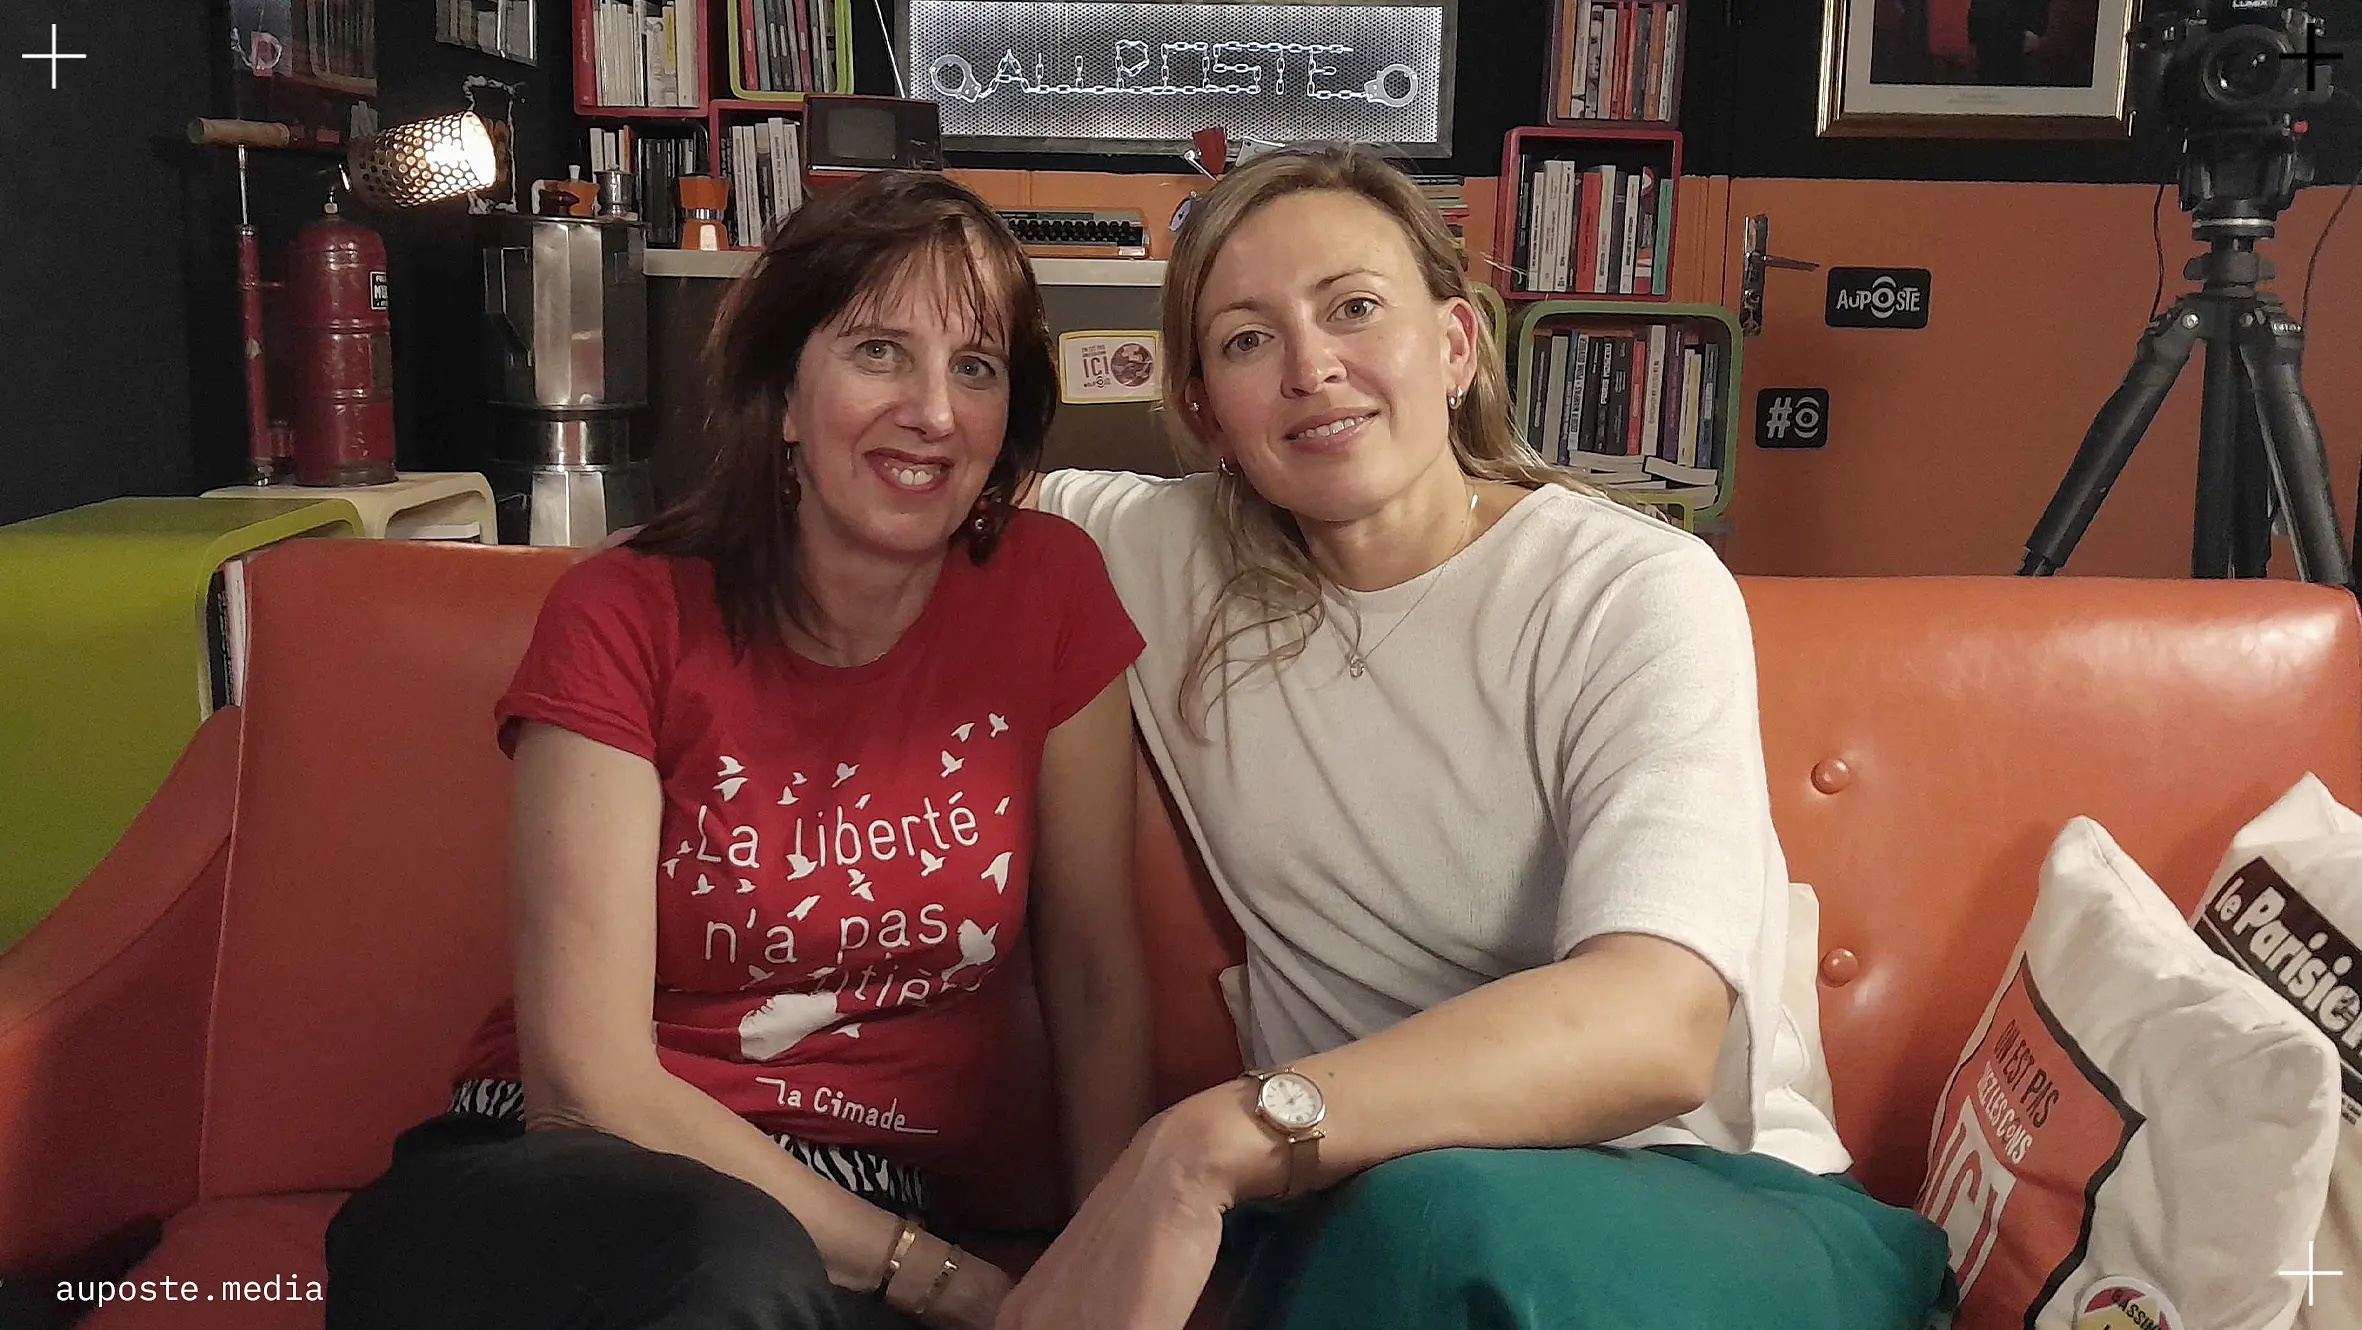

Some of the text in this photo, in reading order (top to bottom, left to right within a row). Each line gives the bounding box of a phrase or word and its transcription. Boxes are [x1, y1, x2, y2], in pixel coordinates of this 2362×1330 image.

[1083, 356, 1109, 378] ICI
[697, 790, 980, 870] La liberté
[2215, 877, 2244, 922] le
[704, 902, 949, 964] n'a pas
[1994, 1019, 2060, 1129] ON EST PAS
[814, 1087, 939, 1133] Cimade
